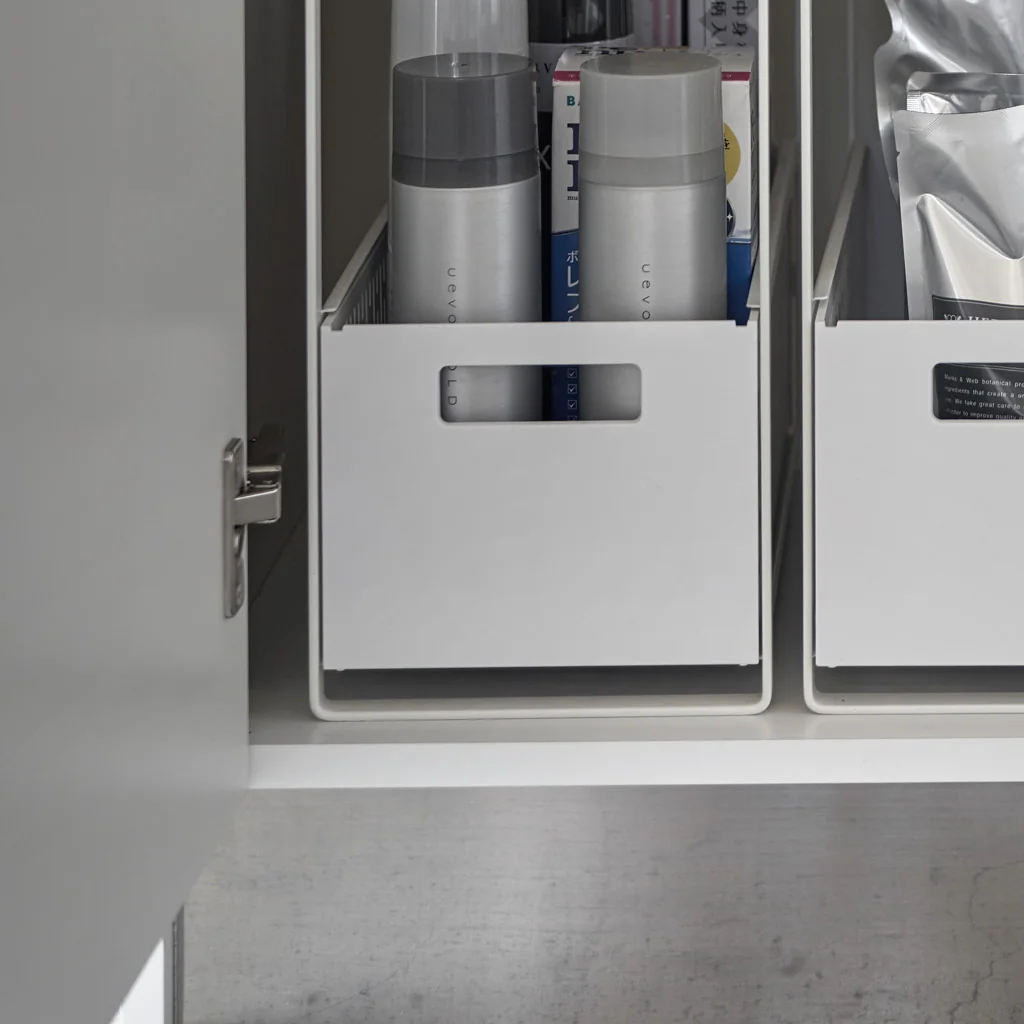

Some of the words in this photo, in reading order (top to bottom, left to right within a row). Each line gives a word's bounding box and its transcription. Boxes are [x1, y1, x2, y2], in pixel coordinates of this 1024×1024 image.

[732, 0, 749, 48] 中身
[641, 263, 651, 321] uevo
[982, 379, 1011, 387] botanical
[970, 411, 994, 419] improve
